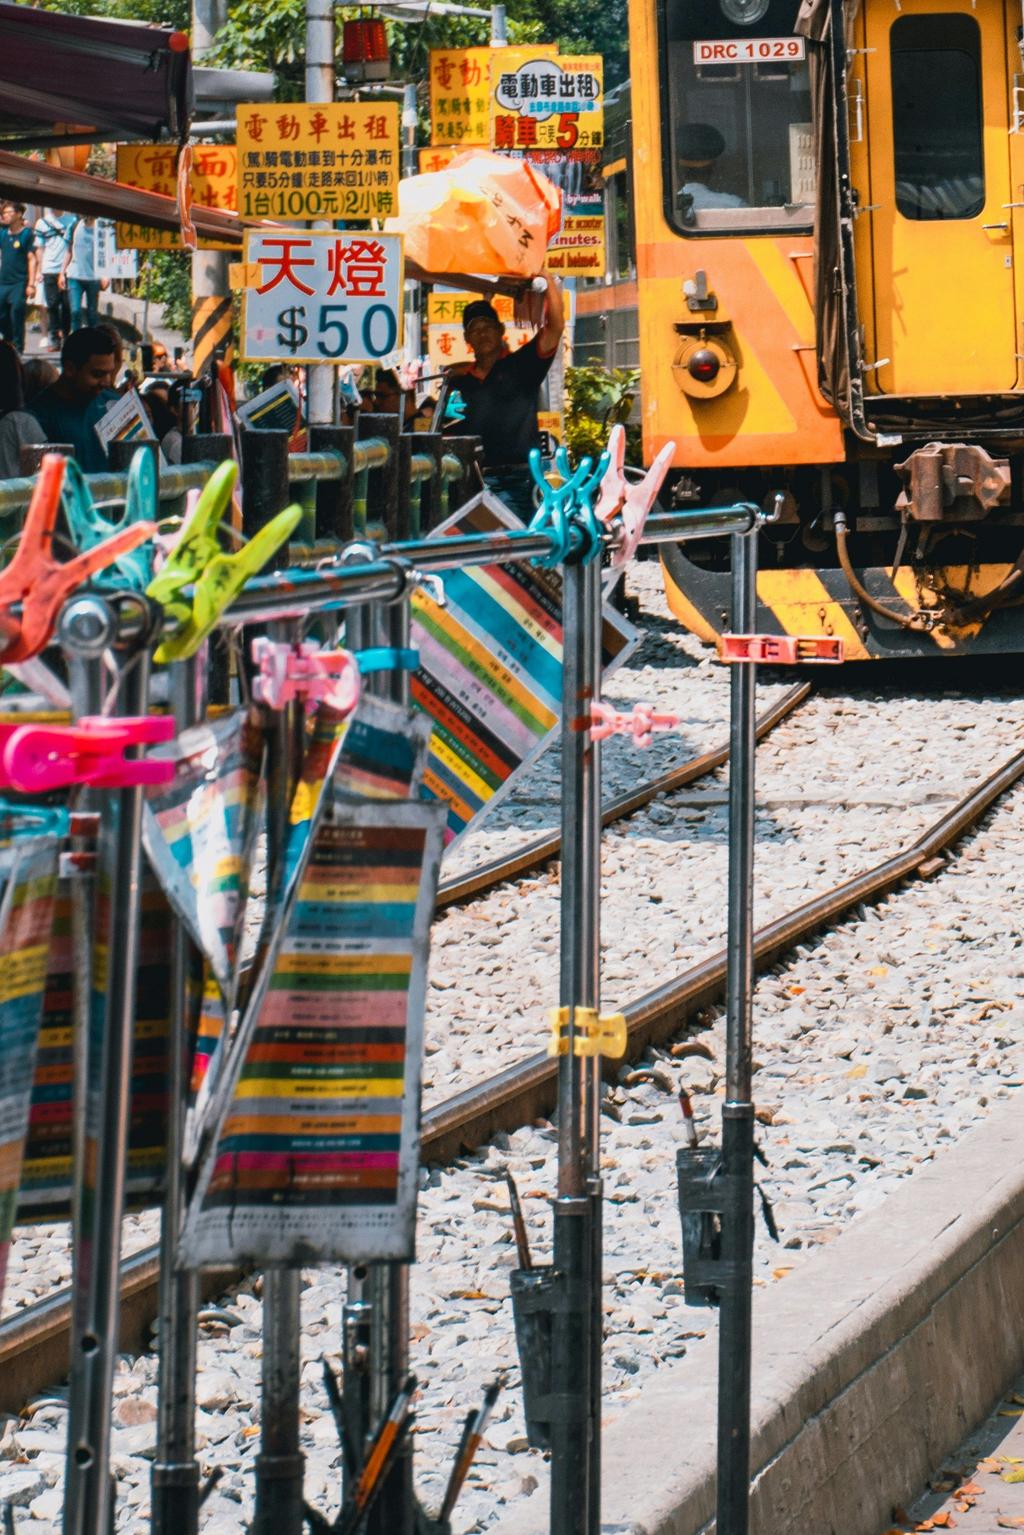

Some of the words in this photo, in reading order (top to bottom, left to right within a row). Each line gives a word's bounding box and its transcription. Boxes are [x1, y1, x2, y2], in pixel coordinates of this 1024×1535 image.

[701, 44, 738, 59] DRC
[745, 42, 799, 57] 1029
[499, 73, 595, 99] 電動車出租
[244, 112, 391, 143] 電動車出租
[554, 233, 602, 245] inutes.
[256, 239, 387, 296] 天燈
[277, 304, 397, 357] $50
